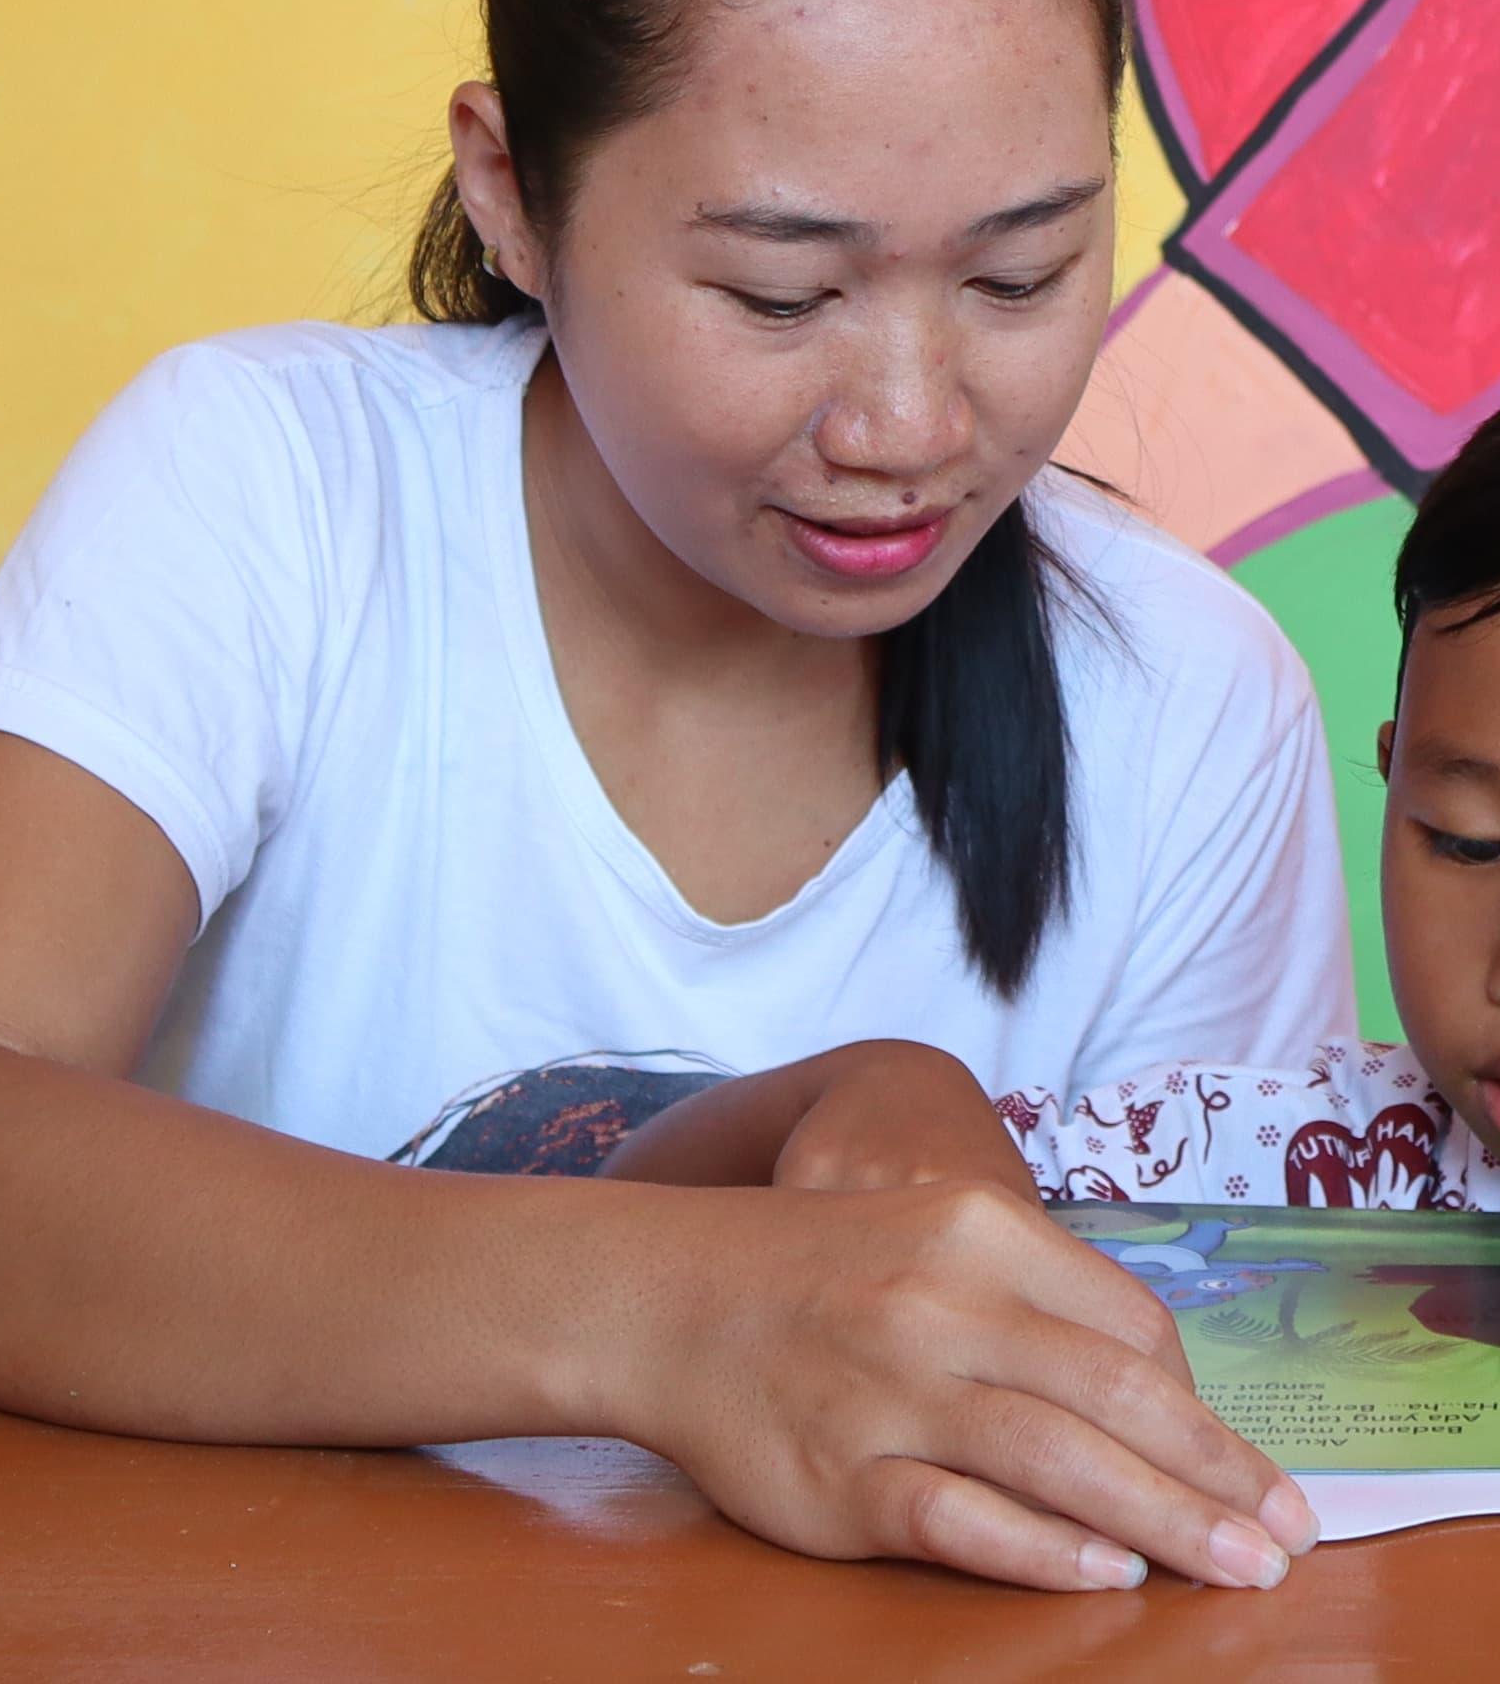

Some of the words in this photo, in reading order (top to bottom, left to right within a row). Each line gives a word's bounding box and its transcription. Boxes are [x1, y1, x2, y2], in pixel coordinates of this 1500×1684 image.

[1236, 1382, 1326, 1392] sangat
[1233, 1393, 1324, 1403] Karena
[1304, 1404, 1375, 1414] Berat
[1282, 1415, 1341, 1425] tahu
[1352, 1412, 1418, 1423] yang
[1428, 1413, 1481, 1423] Ada
[1345, 1425, 1463, 1436] Badanku
[1295, 1438, 1348, 1448] Aku
